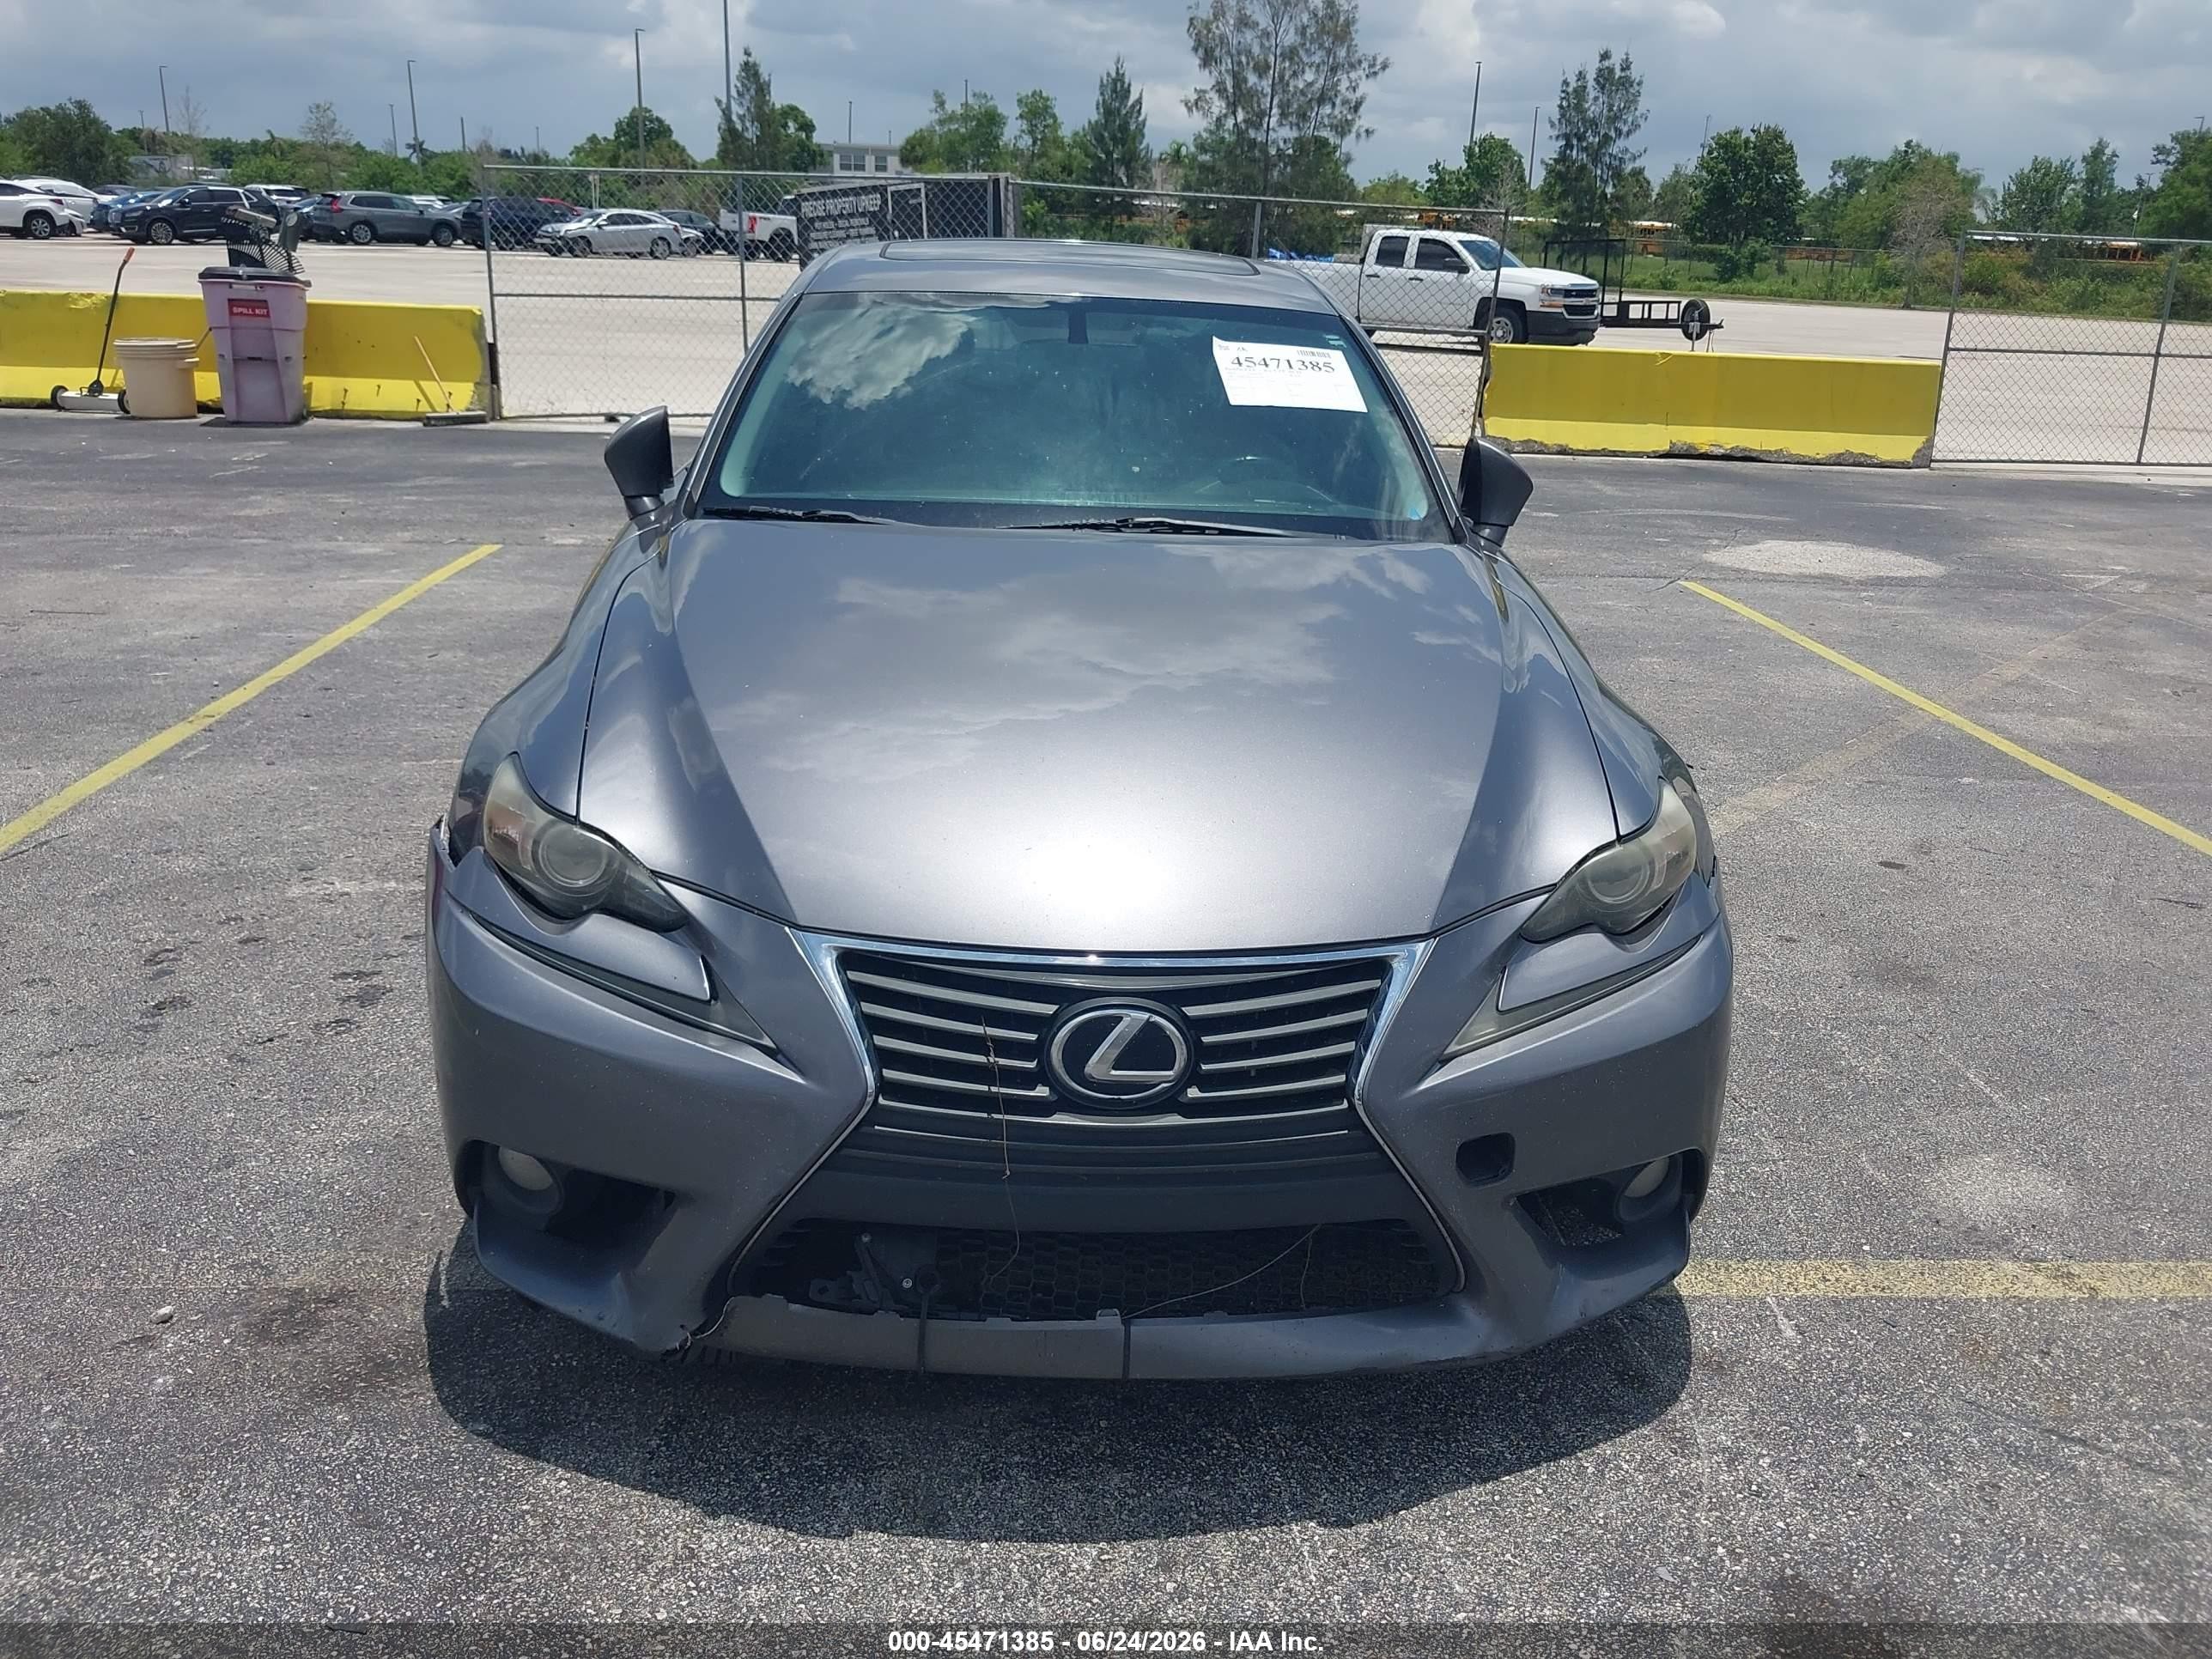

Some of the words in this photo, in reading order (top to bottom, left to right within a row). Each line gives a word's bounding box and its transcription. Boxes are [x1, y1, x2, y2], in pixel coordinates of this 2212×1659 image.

[801, 201, 825, 218] PRECISE
[826, 198, 857, 215] PROPERTY
[858, 193, 881, 212] UPKEEP
[1231, 356, 1335, 374] 45471385
